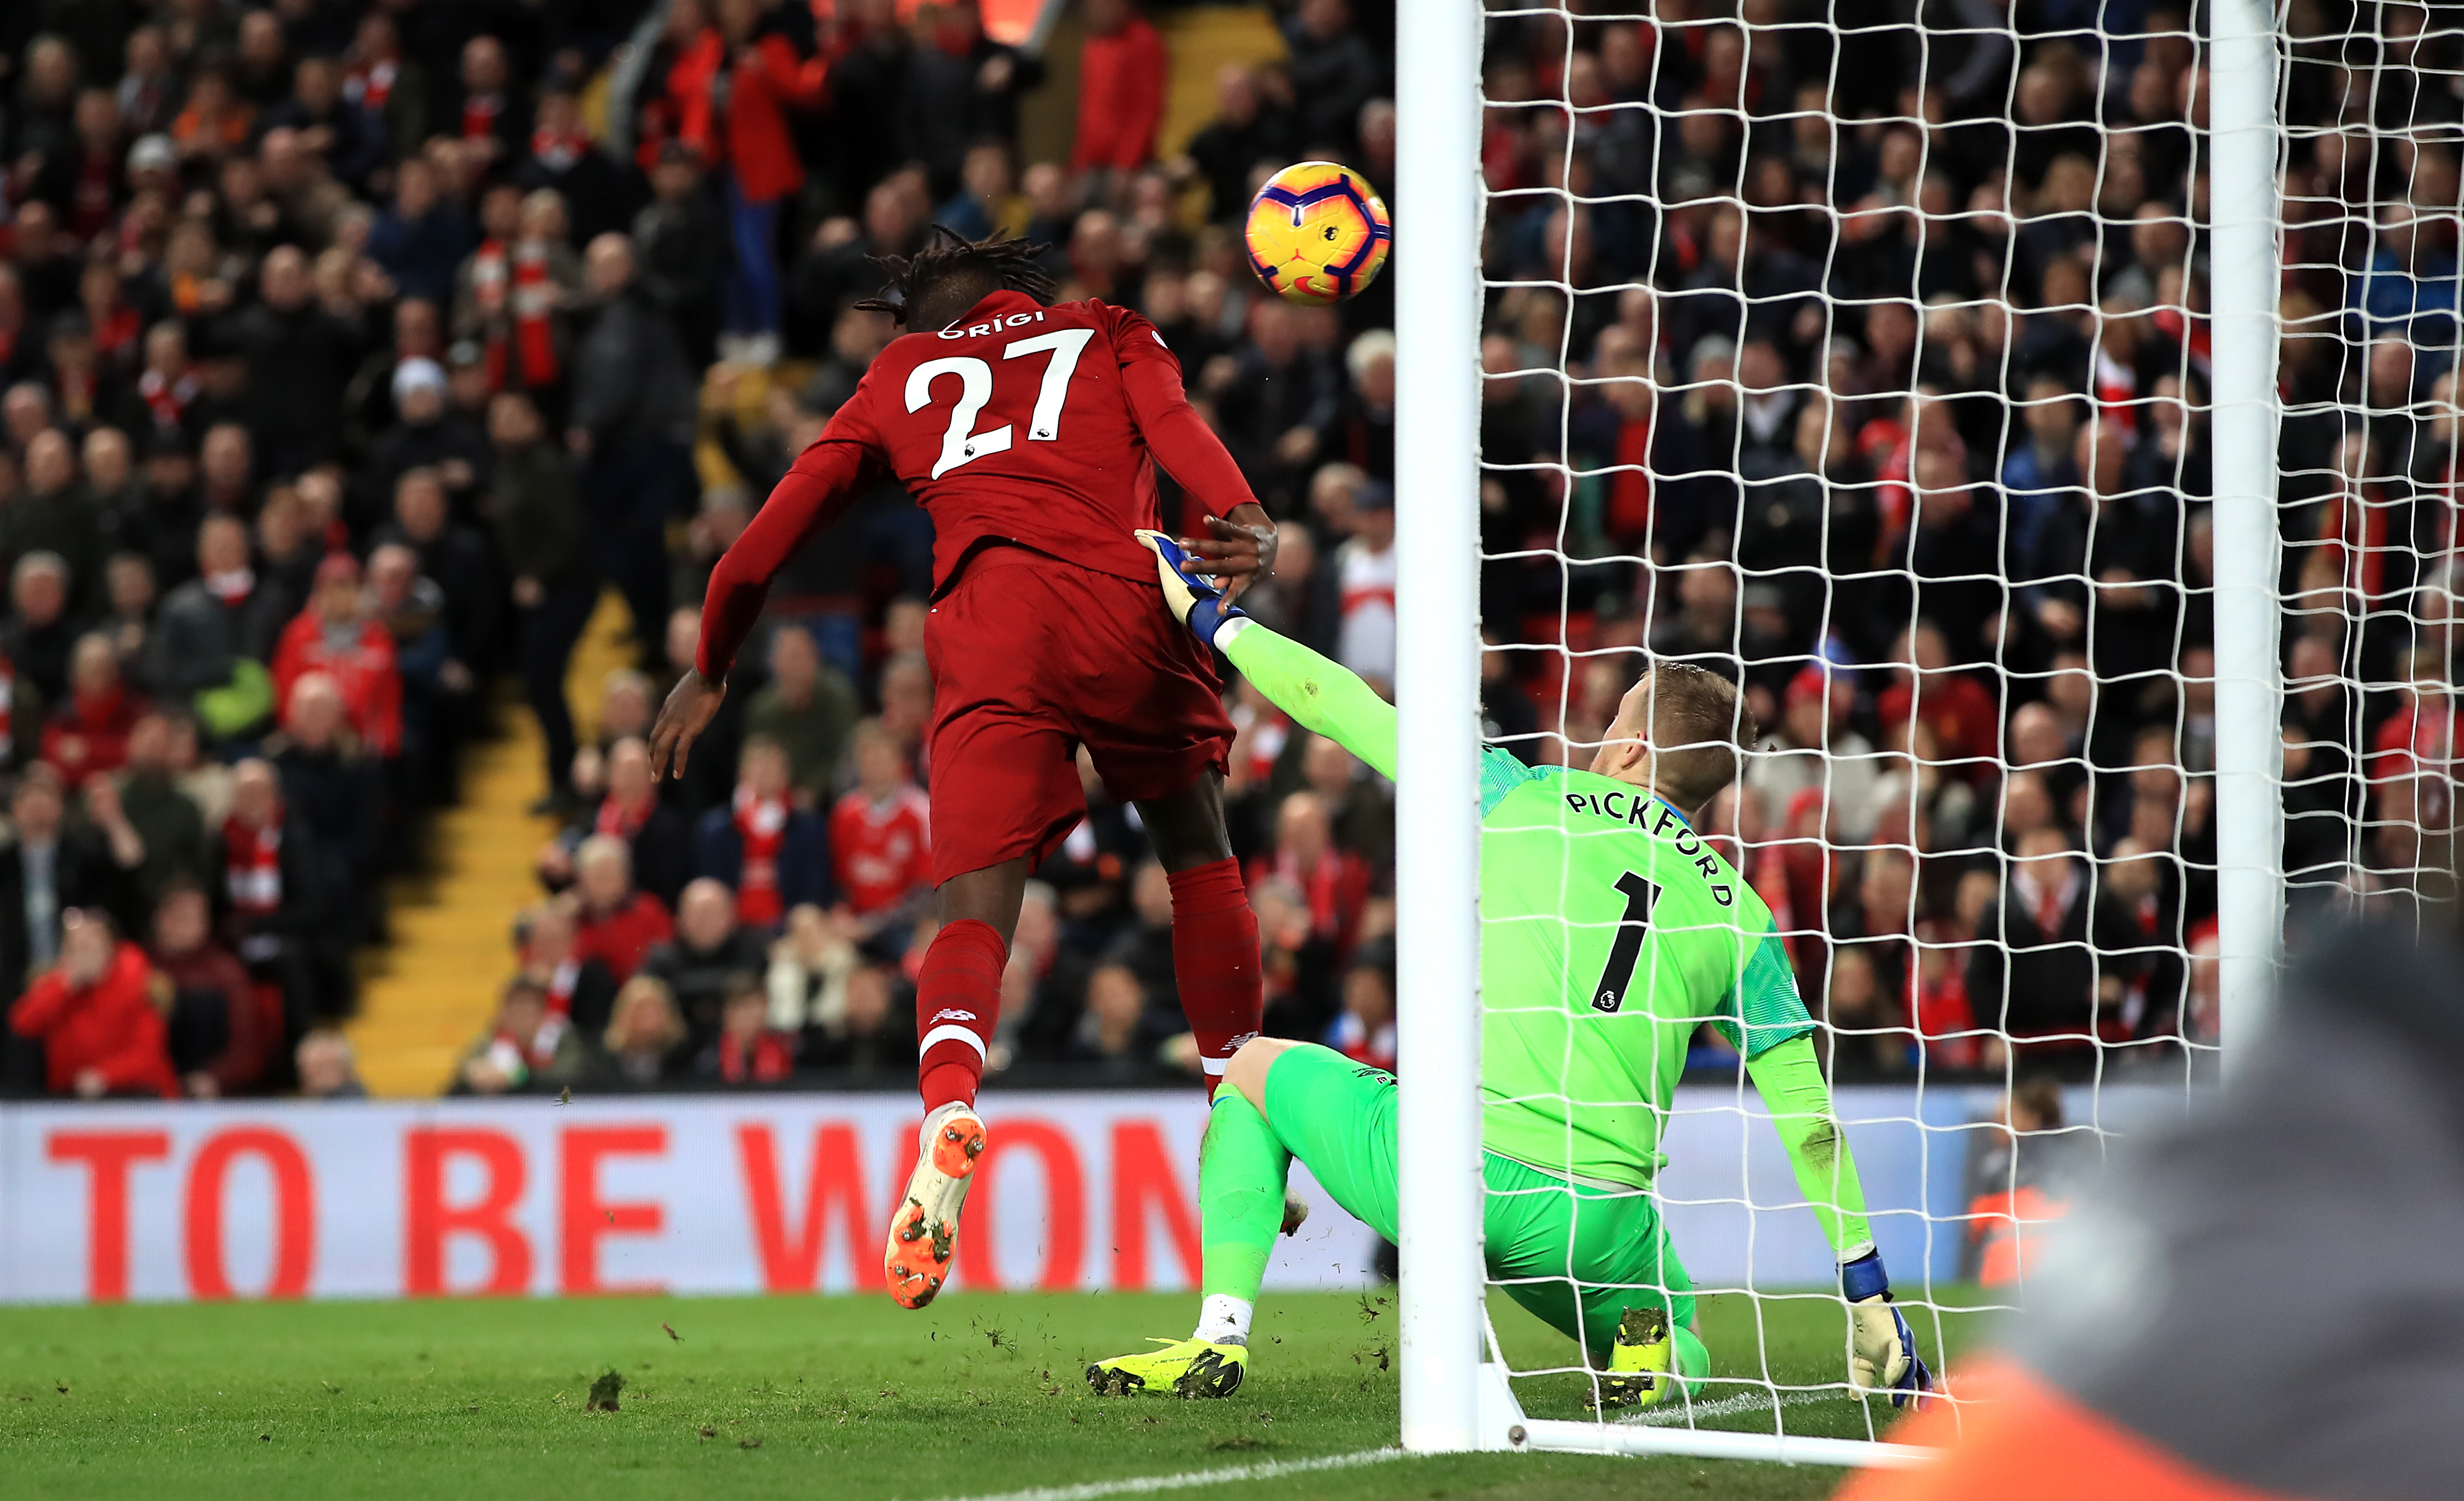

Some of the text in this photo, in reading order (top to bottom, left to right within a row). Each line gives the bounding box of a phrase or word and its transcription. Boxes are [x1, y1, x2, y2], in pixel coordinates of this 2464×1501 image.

[904, 328, 1095, 481] 27
[1565, 791, 1734, 907] PICKFORD
[1591, 871, 1662, 1014] 1
[46, 1123, 320, 1303] TO
[404, 1123, 670, 1299] BE
